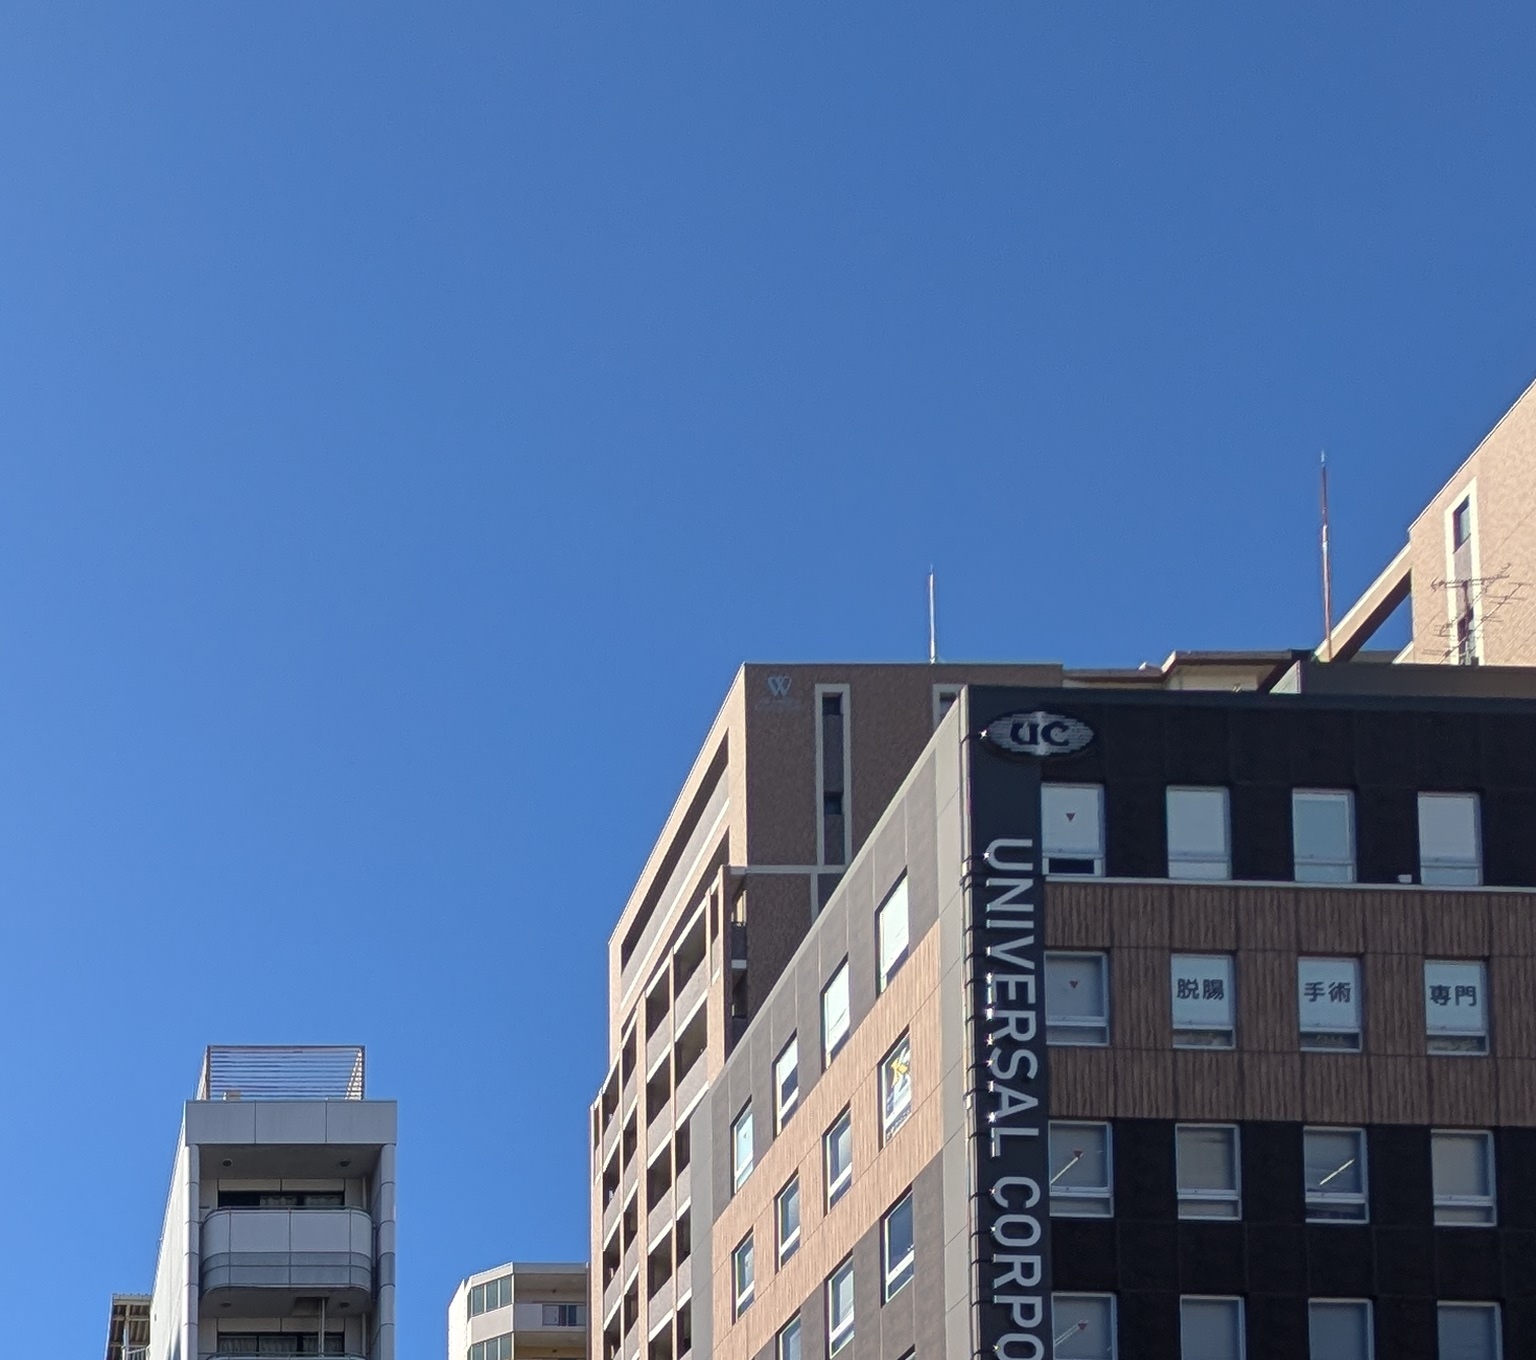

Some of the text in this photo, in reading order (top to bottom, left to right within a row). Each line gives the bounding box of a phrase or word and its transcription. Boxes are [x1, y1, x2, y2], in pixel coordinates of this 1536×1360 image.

[985, 838, 1040, 1158] UNIVERSAL
[1177, 979, 1477, 1006] 脱腸 手術 専門
